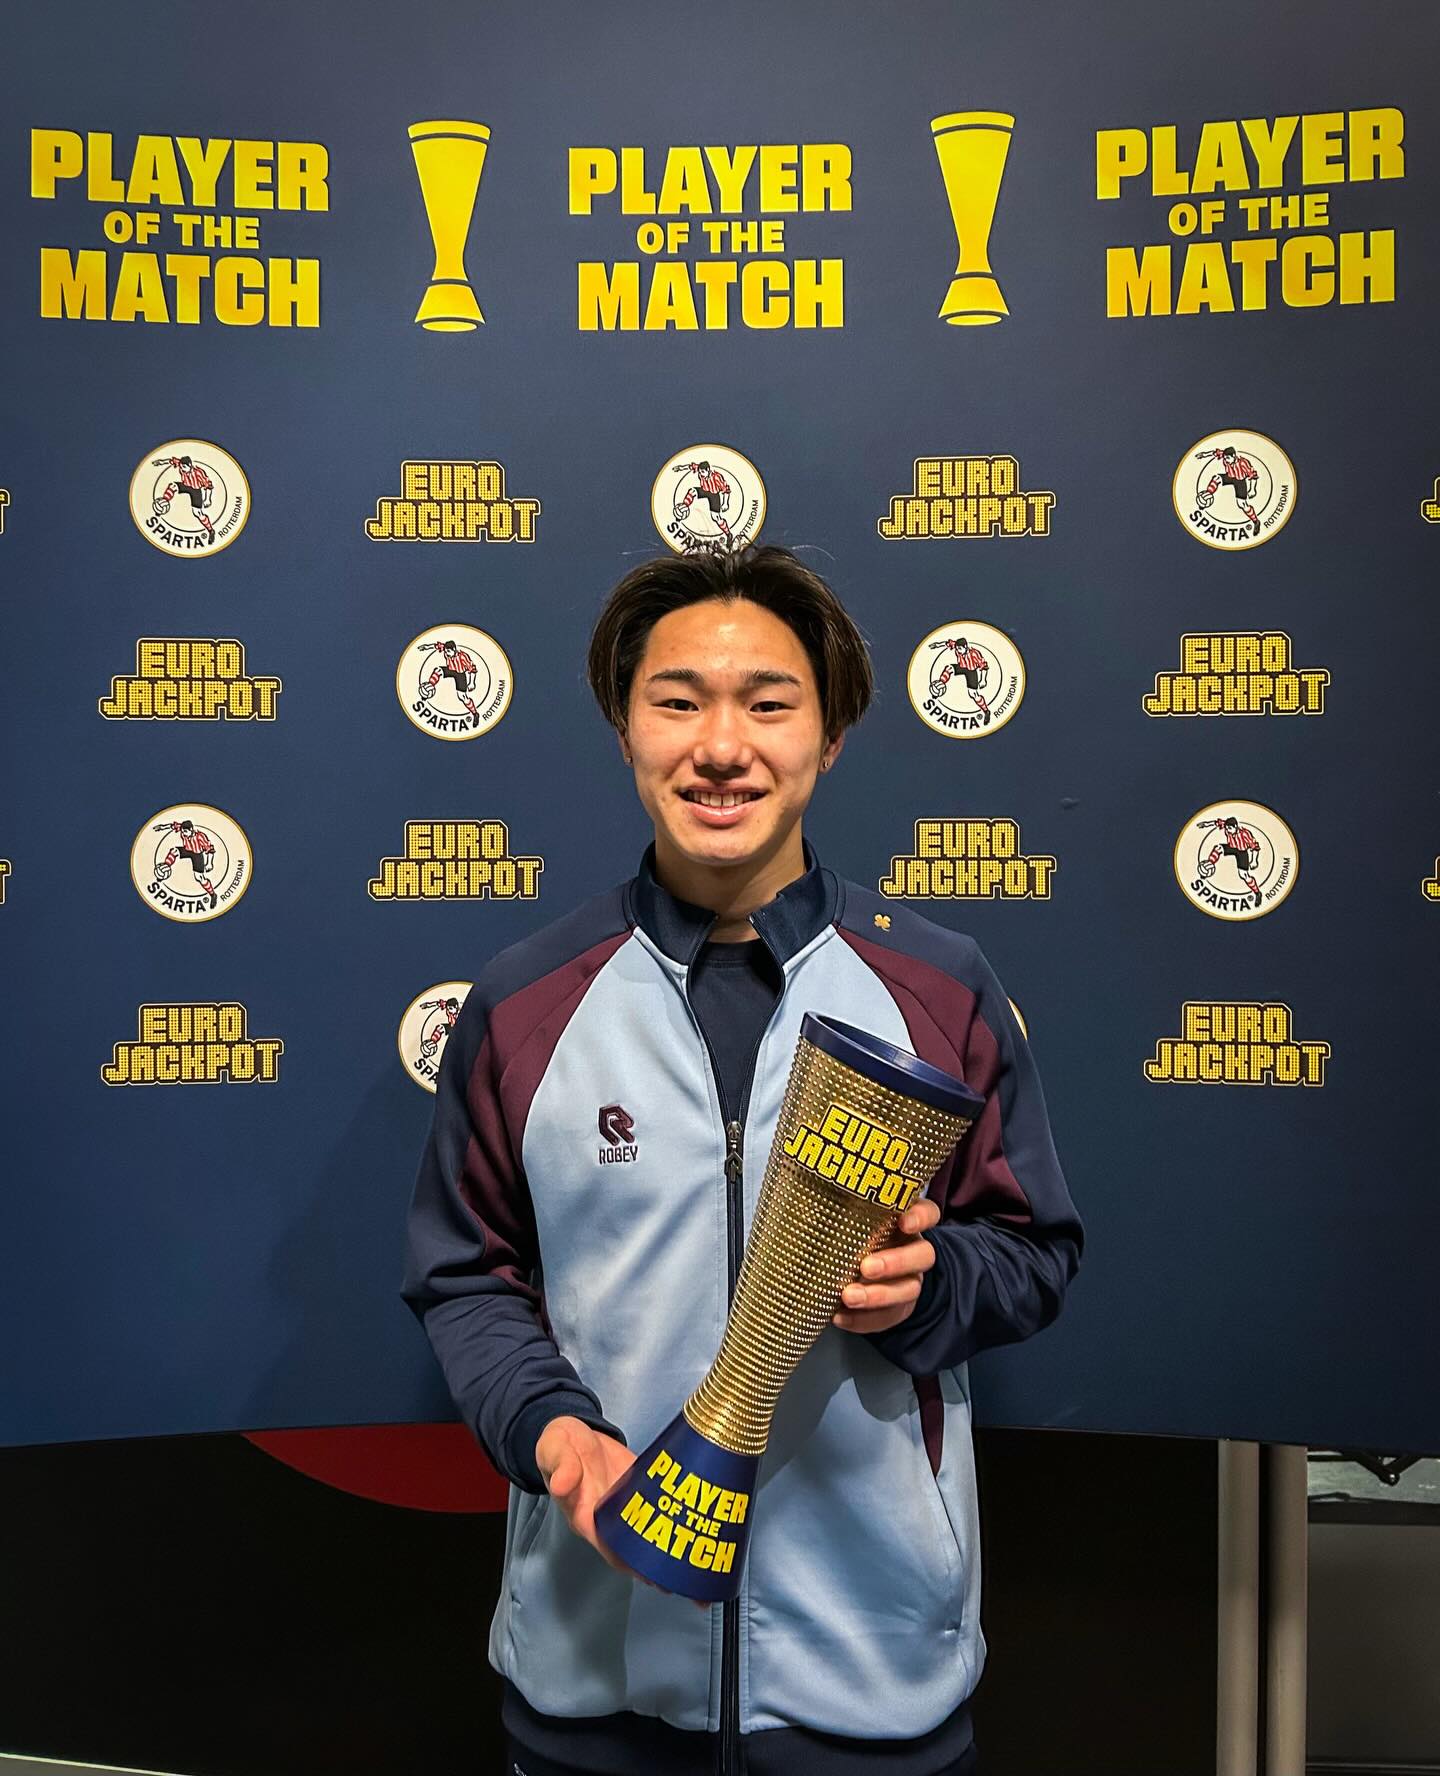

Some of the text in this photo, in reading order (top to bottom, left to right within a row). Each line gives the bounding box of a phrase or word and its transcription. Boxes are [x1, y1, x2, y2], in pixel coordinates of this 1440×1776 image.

[31, 128, 329, 212] PLAYER
[1096, 107, 1405, 200] PLAYER
[568, 144, 852, 215] PLAYER
[103, 210, 259, 249] OF THE
[1168, 193, 1329, 237] OF THE
[637, 221, 784, 253] OF THE
[40, 247, 320, 328] MATCH
[1106, 229, 1395, 318] MATCH
[578, 260, 844, 331] MATCH
[405, 464, 500, 500] EURO
[918, 459, 1014, 497] EURO
[218, 496, 243, 537] ROTTERDAM
[369, 501, 537, 538] JACKPOT
[882, 496, 1052, 535] JACKPOT
[1263, 485, 1289, 528] ROTTERDAM
[141, 642, 240, 678] EURO
[1184, 636, 1286, 673] EURO
[103, 680, 278, 716] JACKPOT
[482, 679, 506, 720] ROTTERDAM
[993, 676, 1018, 718] ROTTERDAM
[1147, 673, 1326, 712] JACKPOT
[408, 824, 504, 859] EURO
[918, 823, 1015, 858] EURO
[220, 860, 245, 901] ROTTERDAM
[372, 861, 540, 896] JACKPOT
[883, 859, 1053, 896] JACKPOT
[1265, 857, 1291, 900] ROTTERDAM
[143, 1006, 242, 1043] EURO
[1186, 1006, 1287, 1044] EURO
[105, 1043, 280, 1082] JACKPOT
[413, 1058, 438, 1084] SPA
[1148, 1043, 1326, 1082] JACKPOT
[598, 1145, 639, 1165] ROBEY
[820, 1106, 910, 1172] EURO
[782, 1126, 920, 1211] JACKPOT
[646, 1449, 749, 1524] PLAYER
[620, 1491, 737, 1573] MATCH
[657, 1495, 722, 1538] OF THE
